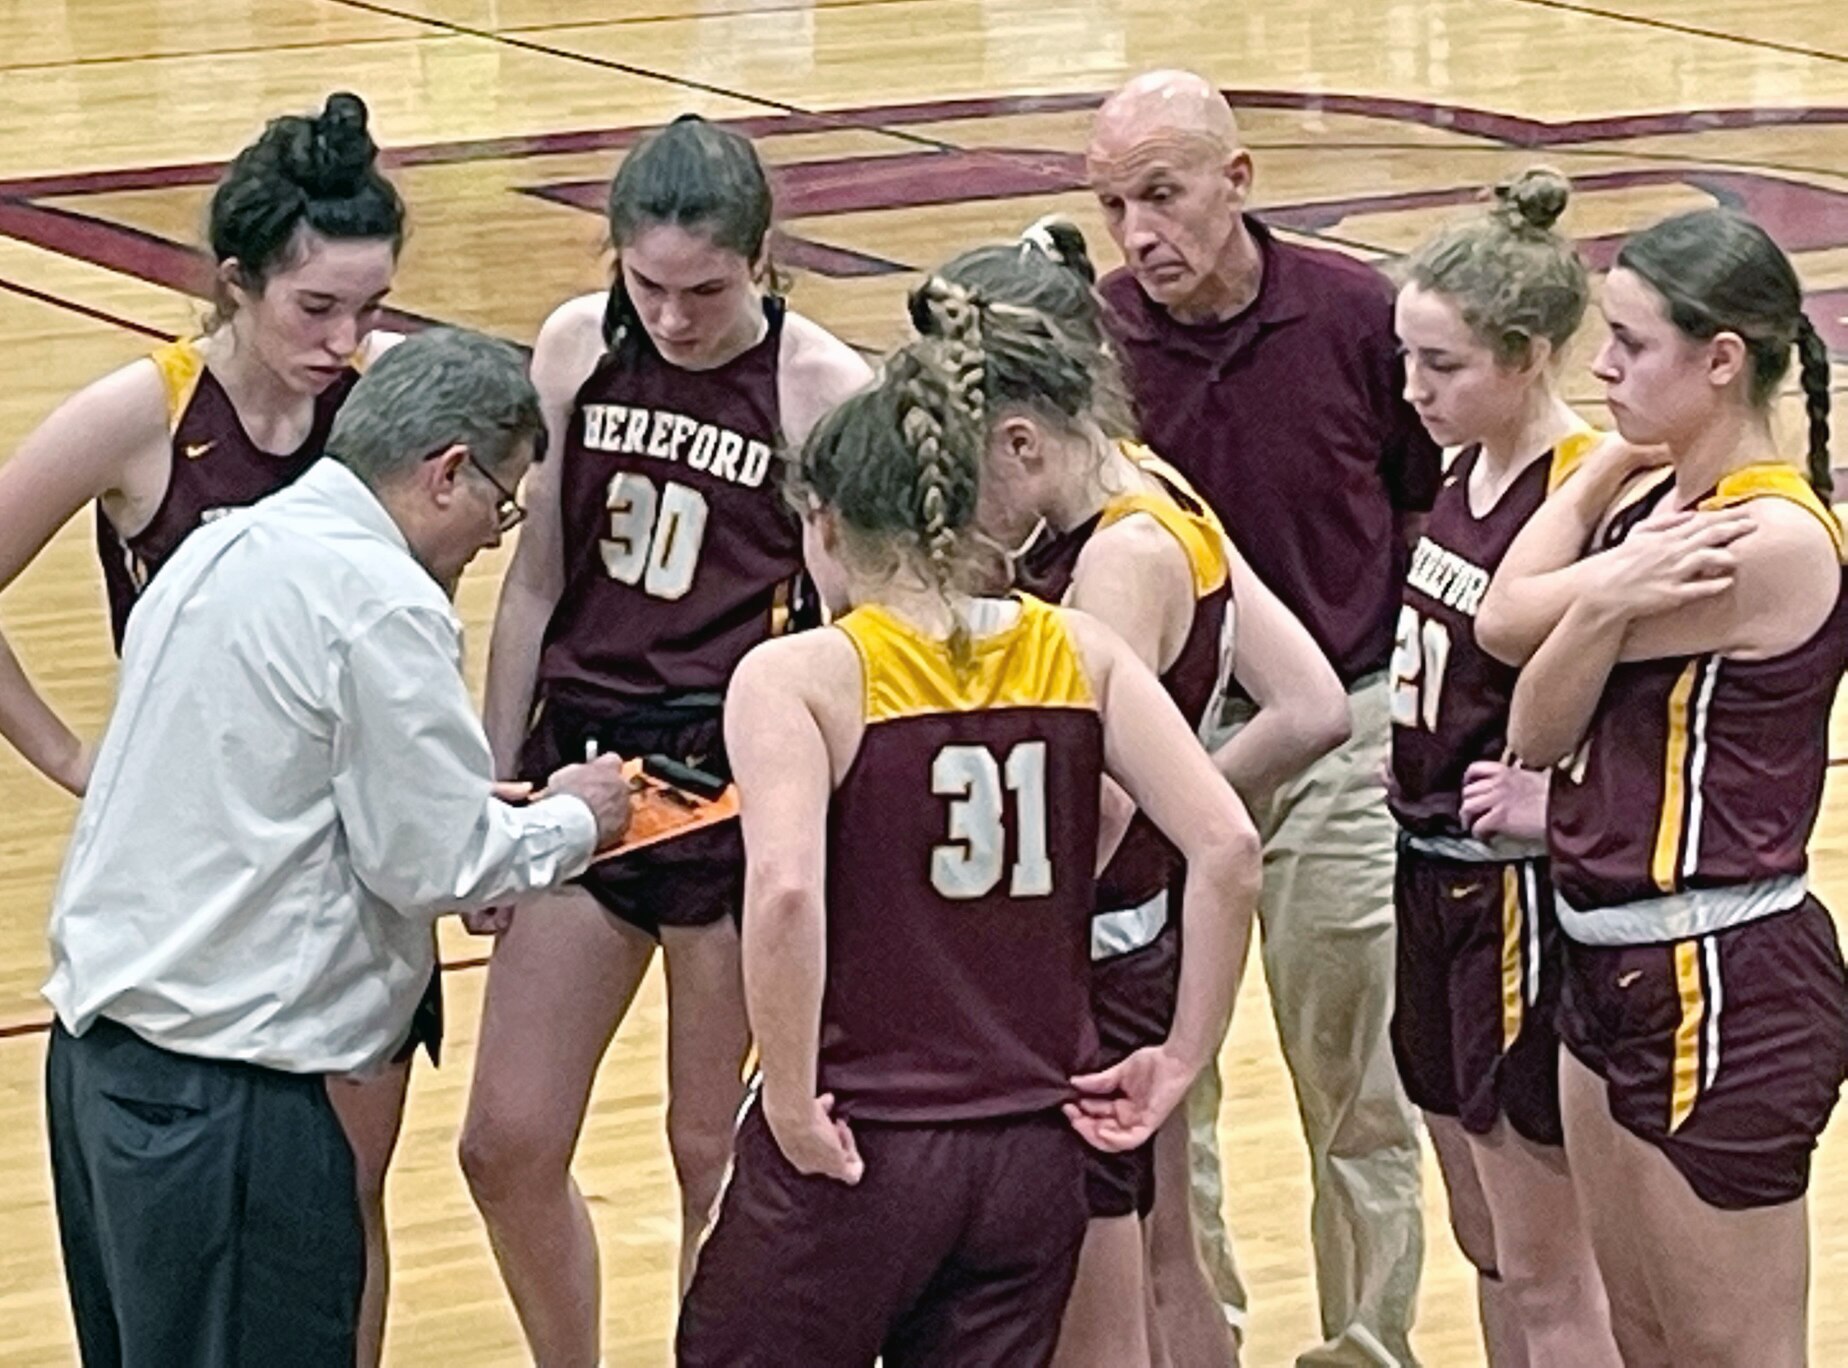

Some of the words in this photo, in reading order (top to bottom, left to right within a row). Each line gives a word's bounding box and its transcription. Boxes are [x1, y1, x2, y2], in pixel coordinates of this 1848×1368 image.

[582, 403, 772, 488] HEREFORD
[599, 471, 710, 601] 30
[930, 740, 1054, 899] 31
